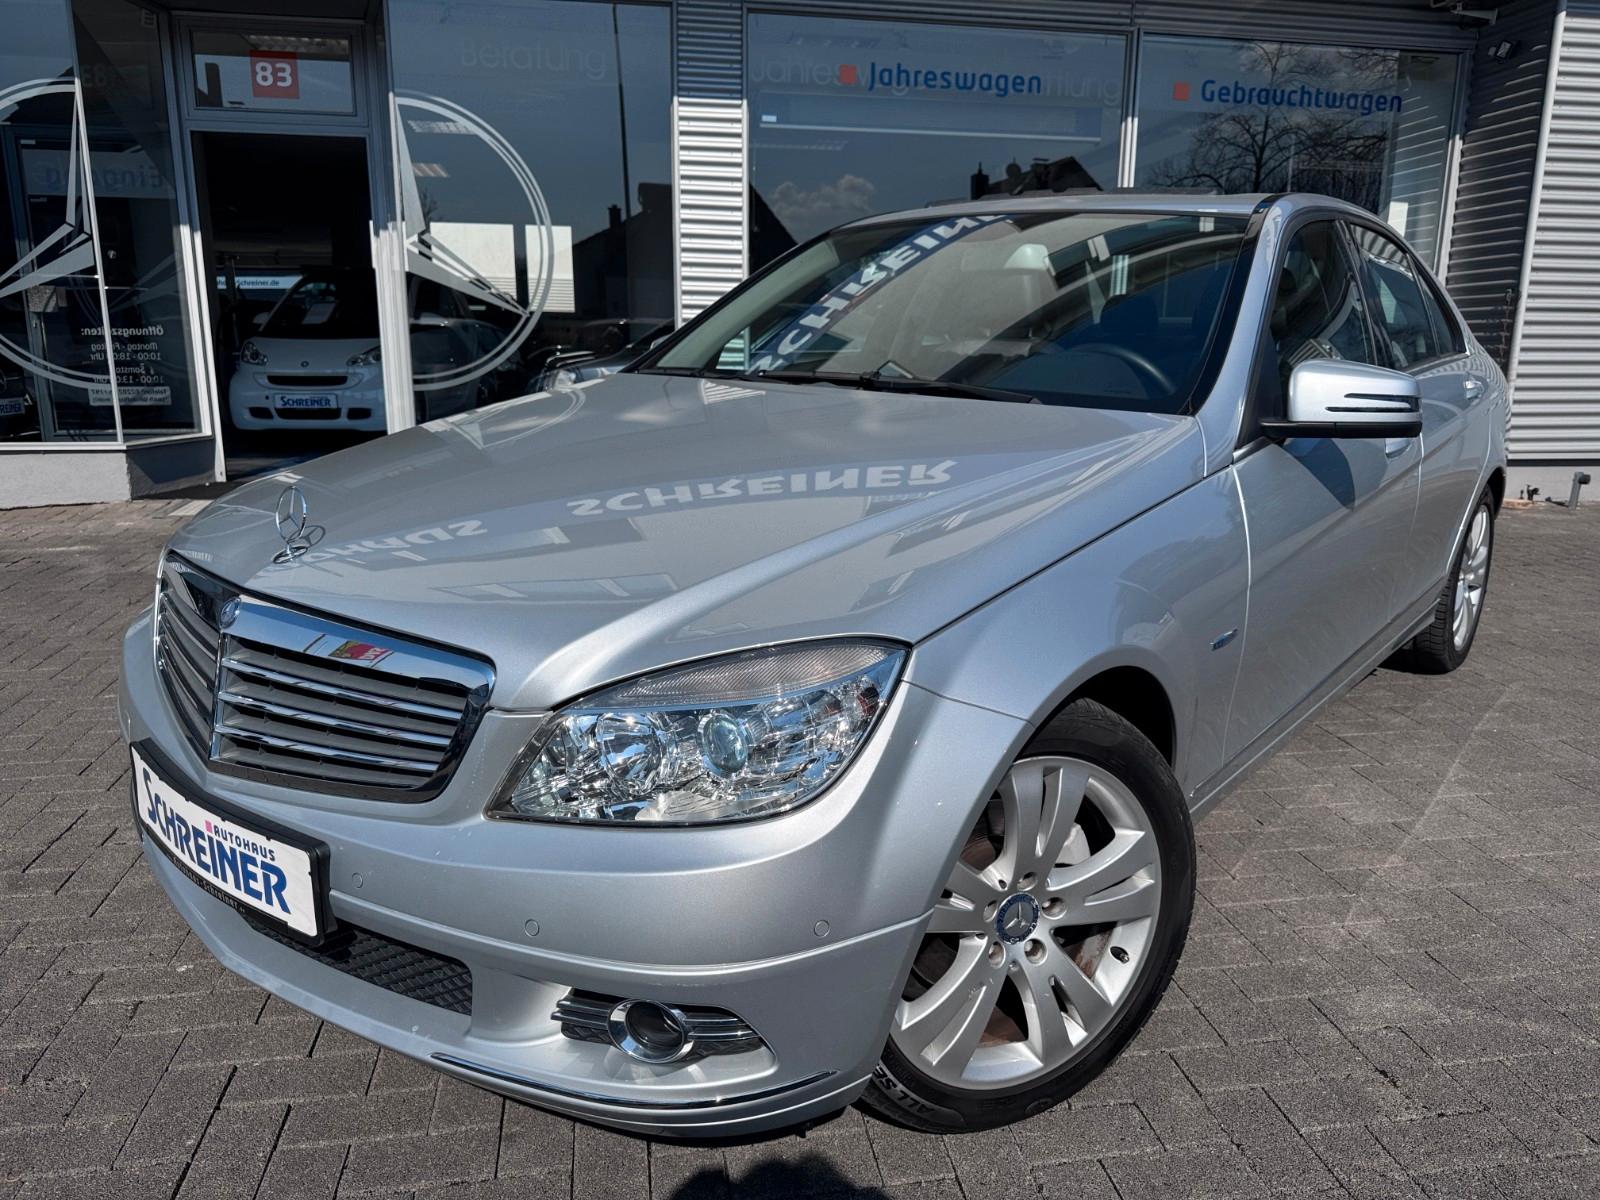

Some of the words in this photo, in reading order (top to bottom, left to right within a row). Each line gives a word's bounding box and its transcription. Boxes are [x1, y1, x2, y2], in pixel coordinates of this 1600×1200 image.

[255, 61, 292, 87] 83
[460, 38, 606, 80] Beratung
[868, 62, 1041, 98] Jahreswagen
[1200, 79, 1403, 117] Gebrauchtwagen
[280, 396, 331, 407] SCHREINER
[142, 767, 291, 915] SCHREINER
[213, 825, 276, 862] AUTOHAUS
[873, 1063, 898, 1090] SE
[898, 1090, 935, 1113] ALL
